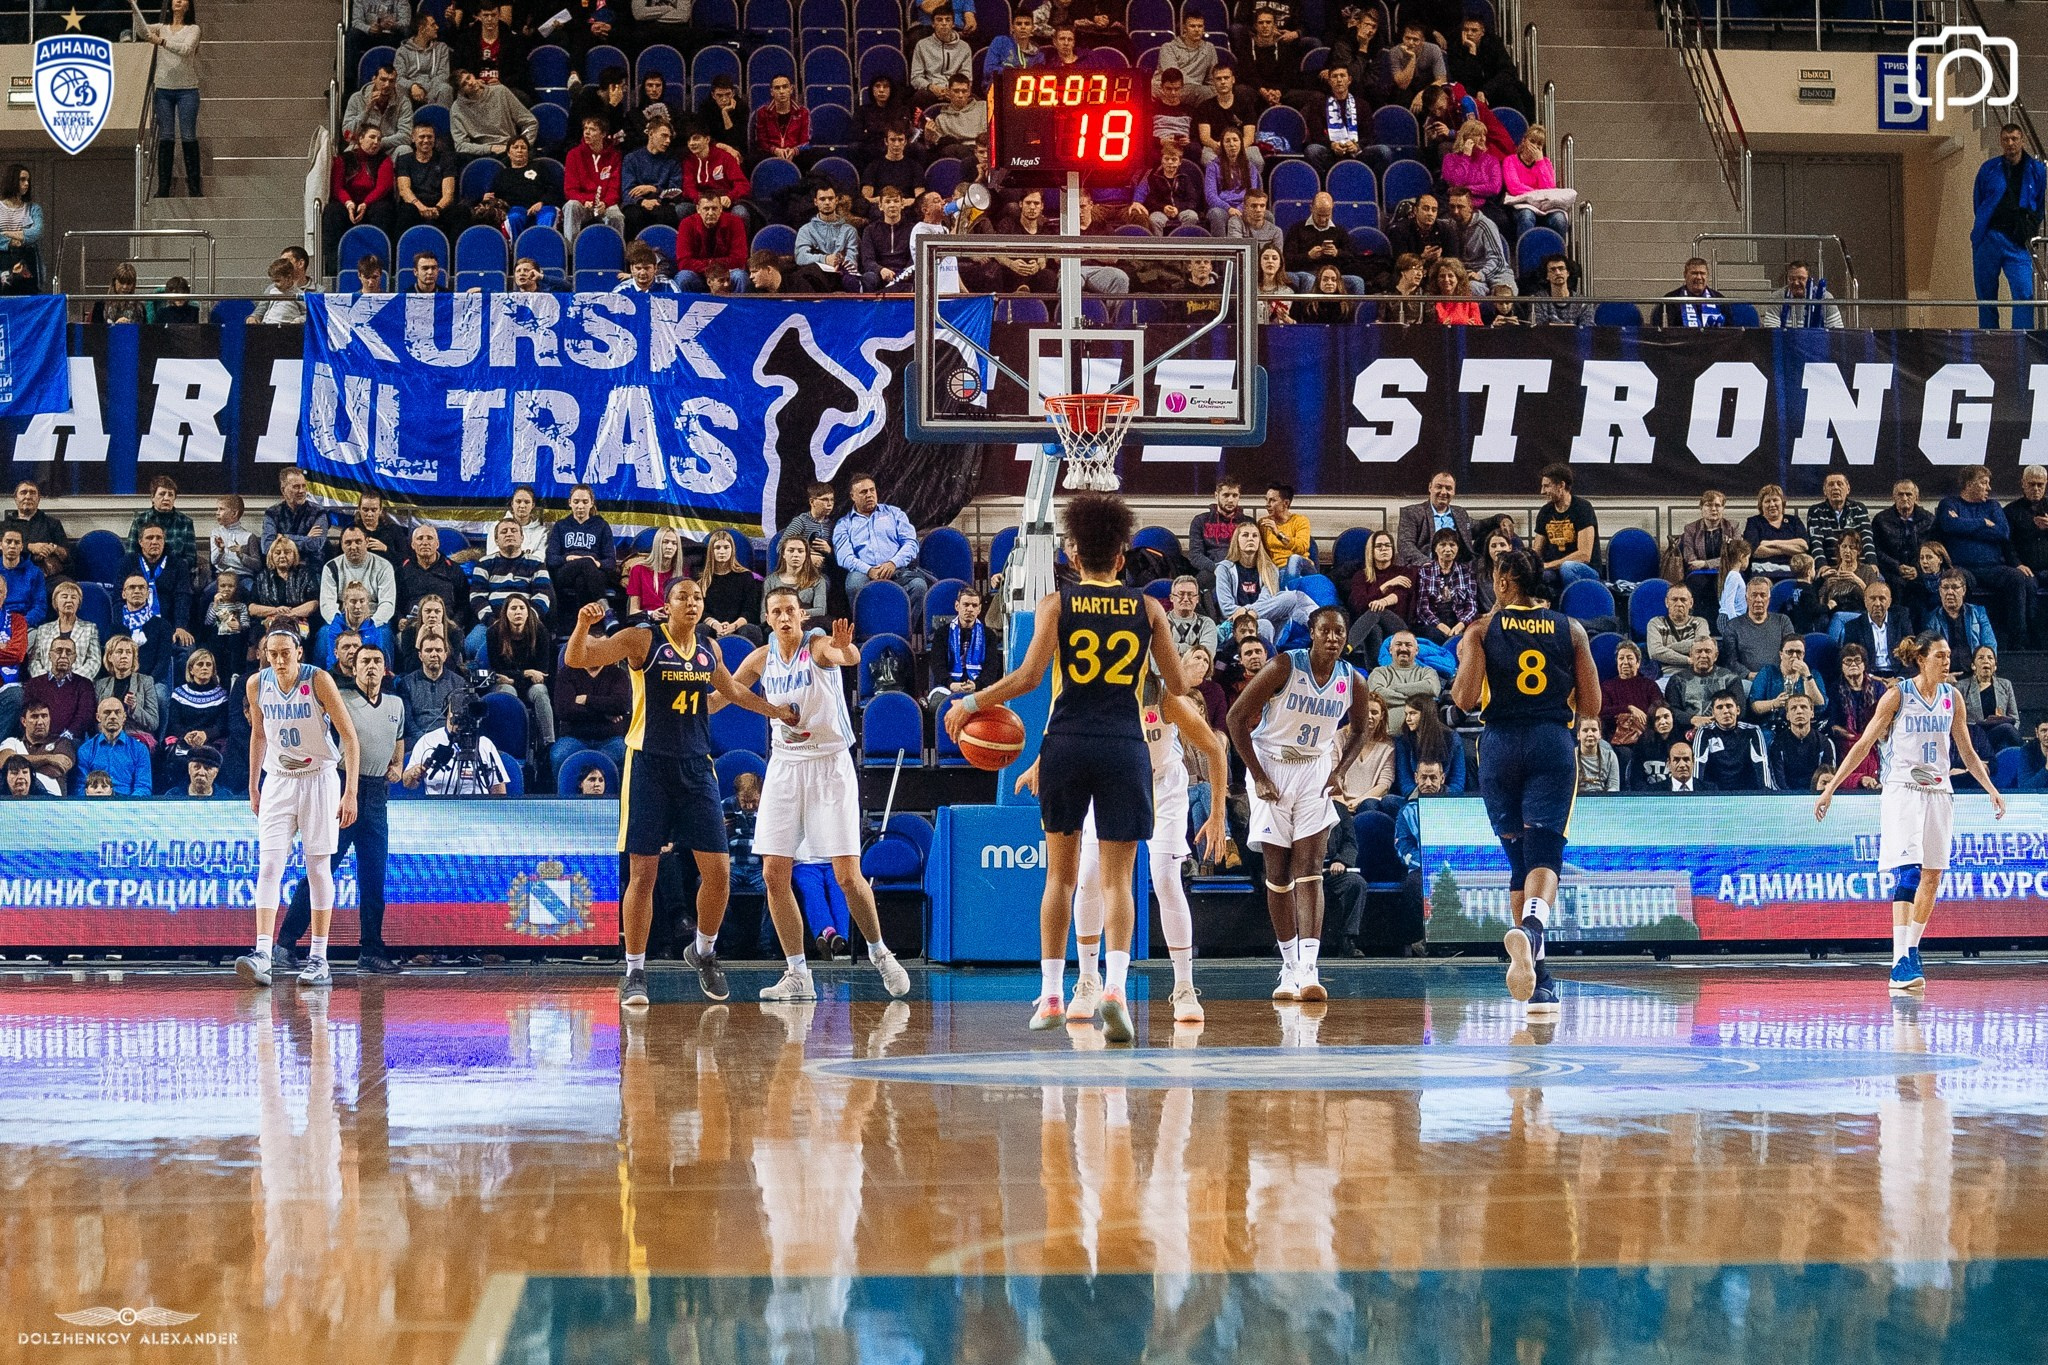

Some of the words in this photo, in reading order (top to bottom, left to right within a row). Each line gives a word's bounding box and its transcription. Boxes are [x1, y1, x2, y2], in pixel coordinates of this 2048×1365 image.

[1802, 71, 1829, 79] ВЫХОД
[1884, 62, 1922, 71] ТРИБУА
[1801, 89, 1833, 99] ВЫХОД
[1077, 110, 1133, 161] 18
[1010, 157, 1041, 168] MegaS
[324, 293, 728, 380] KURSK
[309, 361, 740, 495] ULTRAS
[565, 532, 596, 549] GAP
[1071, 597, 1138, 615] HARTLEY
[1501, 616, 1555, 634] VAUGHN
[1068, 629, 1140, 685] 32
[767, 669, 812, 694] DYNAMO
[1517, 649, 1547, 695] 8
[263, 703, 311, 719] DYNAMO
[672, 691, 699, 714] 41
[1286, 693, 1344, 718] DYNAMO
[1297, 723, 1321, 748] 31
[1906, 716, 1951, 733] DYNAM
[280, 727, 301, 748] 30
[98, 839, 158, 868] ПРИ
[981, 840, 1047, 869] mol
